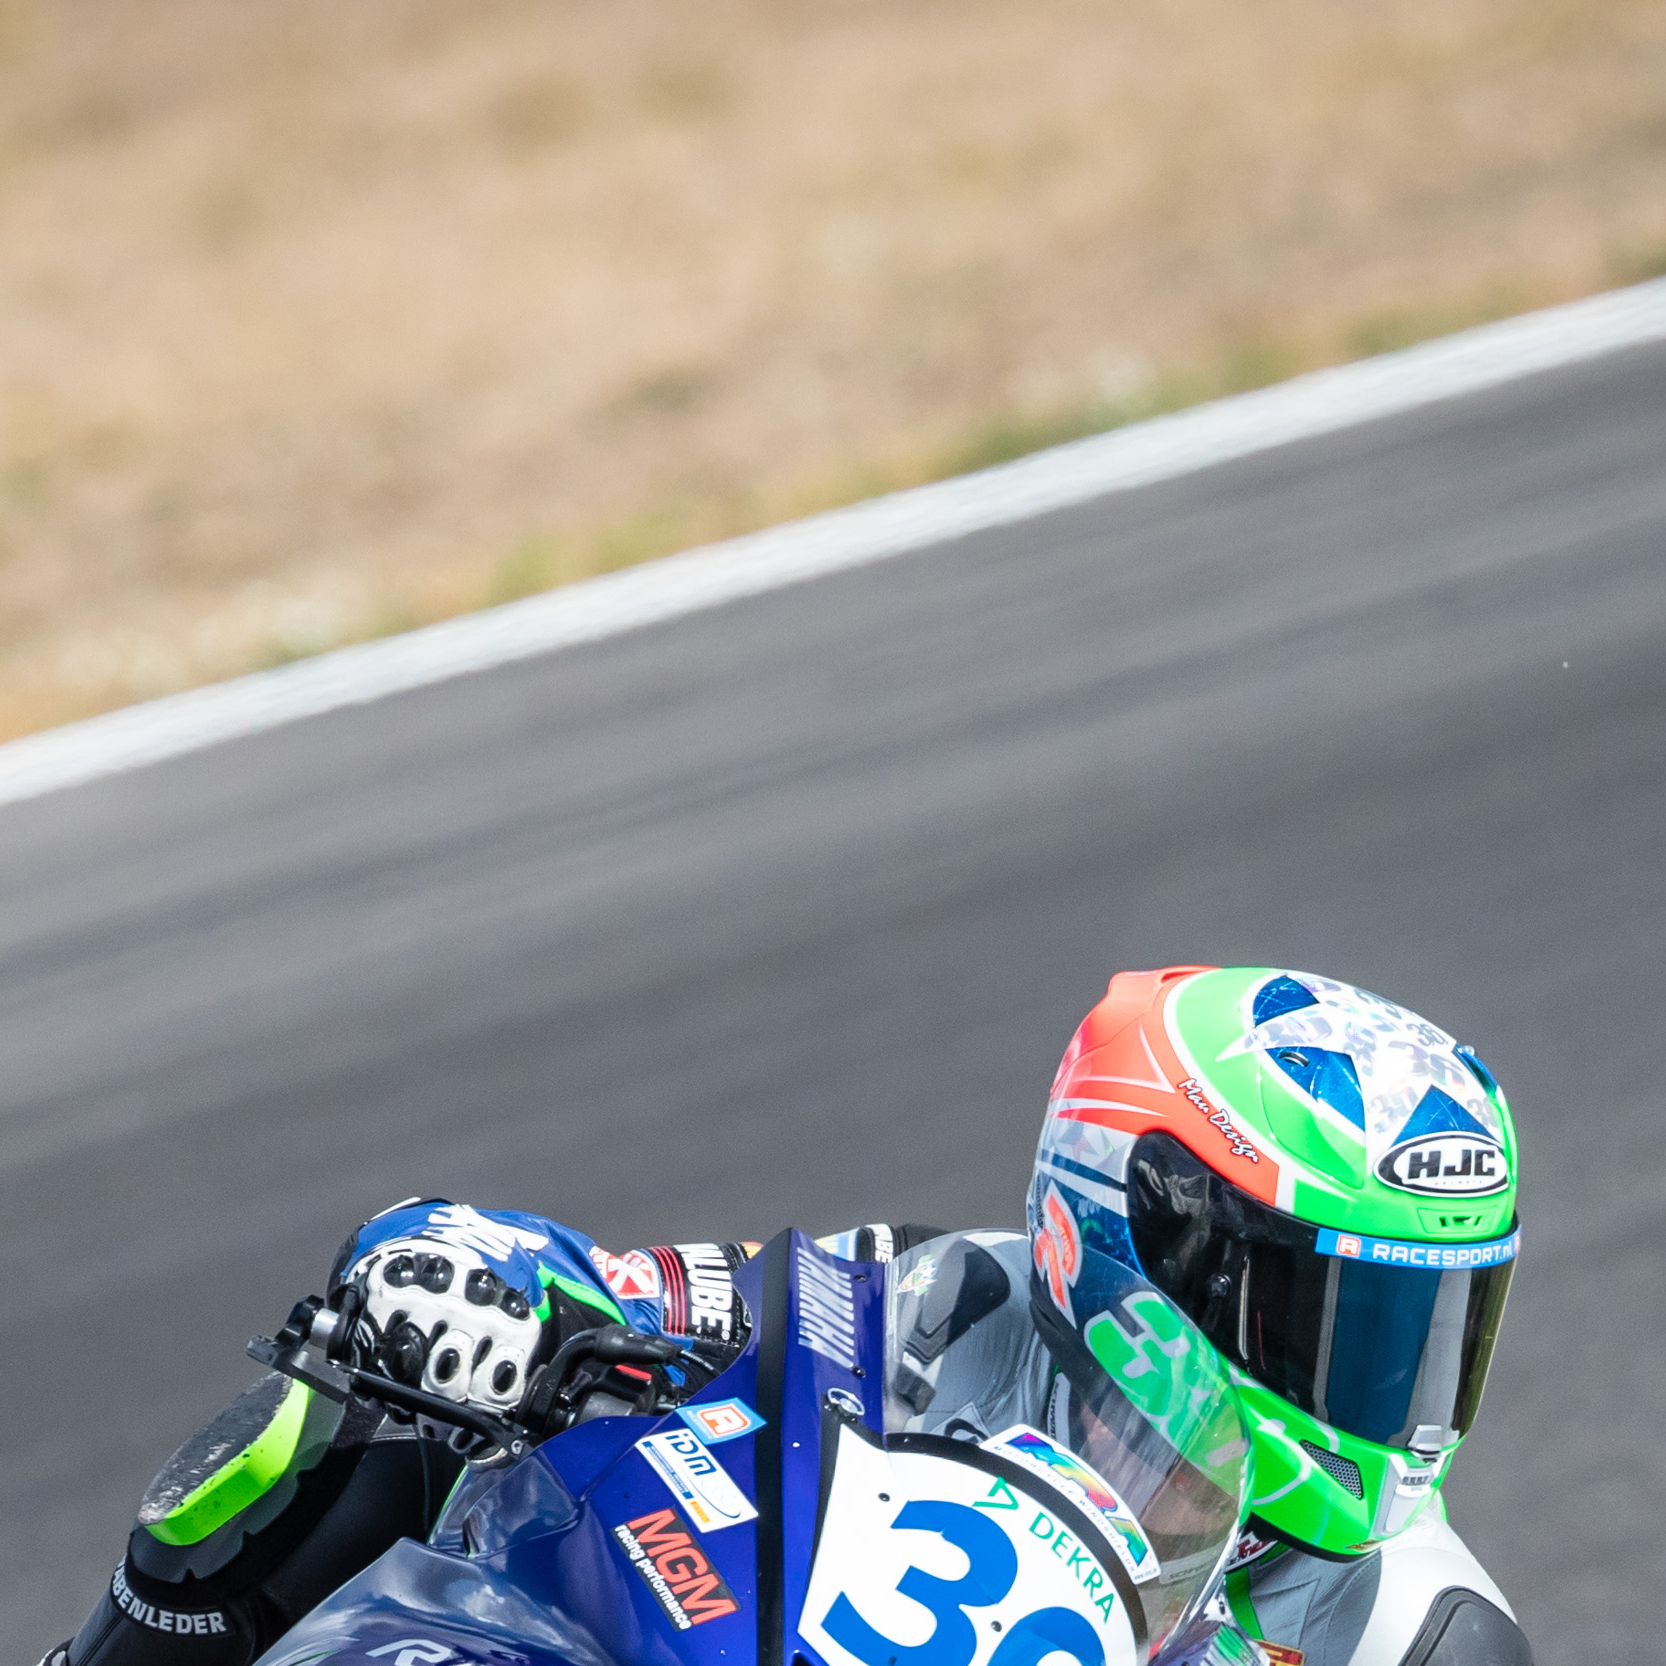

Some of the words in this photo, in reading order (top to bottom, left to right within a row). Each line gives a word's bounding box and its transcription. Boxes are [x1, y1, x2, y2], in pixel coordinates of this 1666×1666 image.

[1207, 1106, 1260, 1166] Design
[1407, 1148, 1496, 1180] HJC
[614, 1523, 646, 1561] racing
[635, 1557, 693, 1631] performance
[627, 1508, 737, 1626] MGM
[1028, 1511, 1115, 1621] DEKRA
